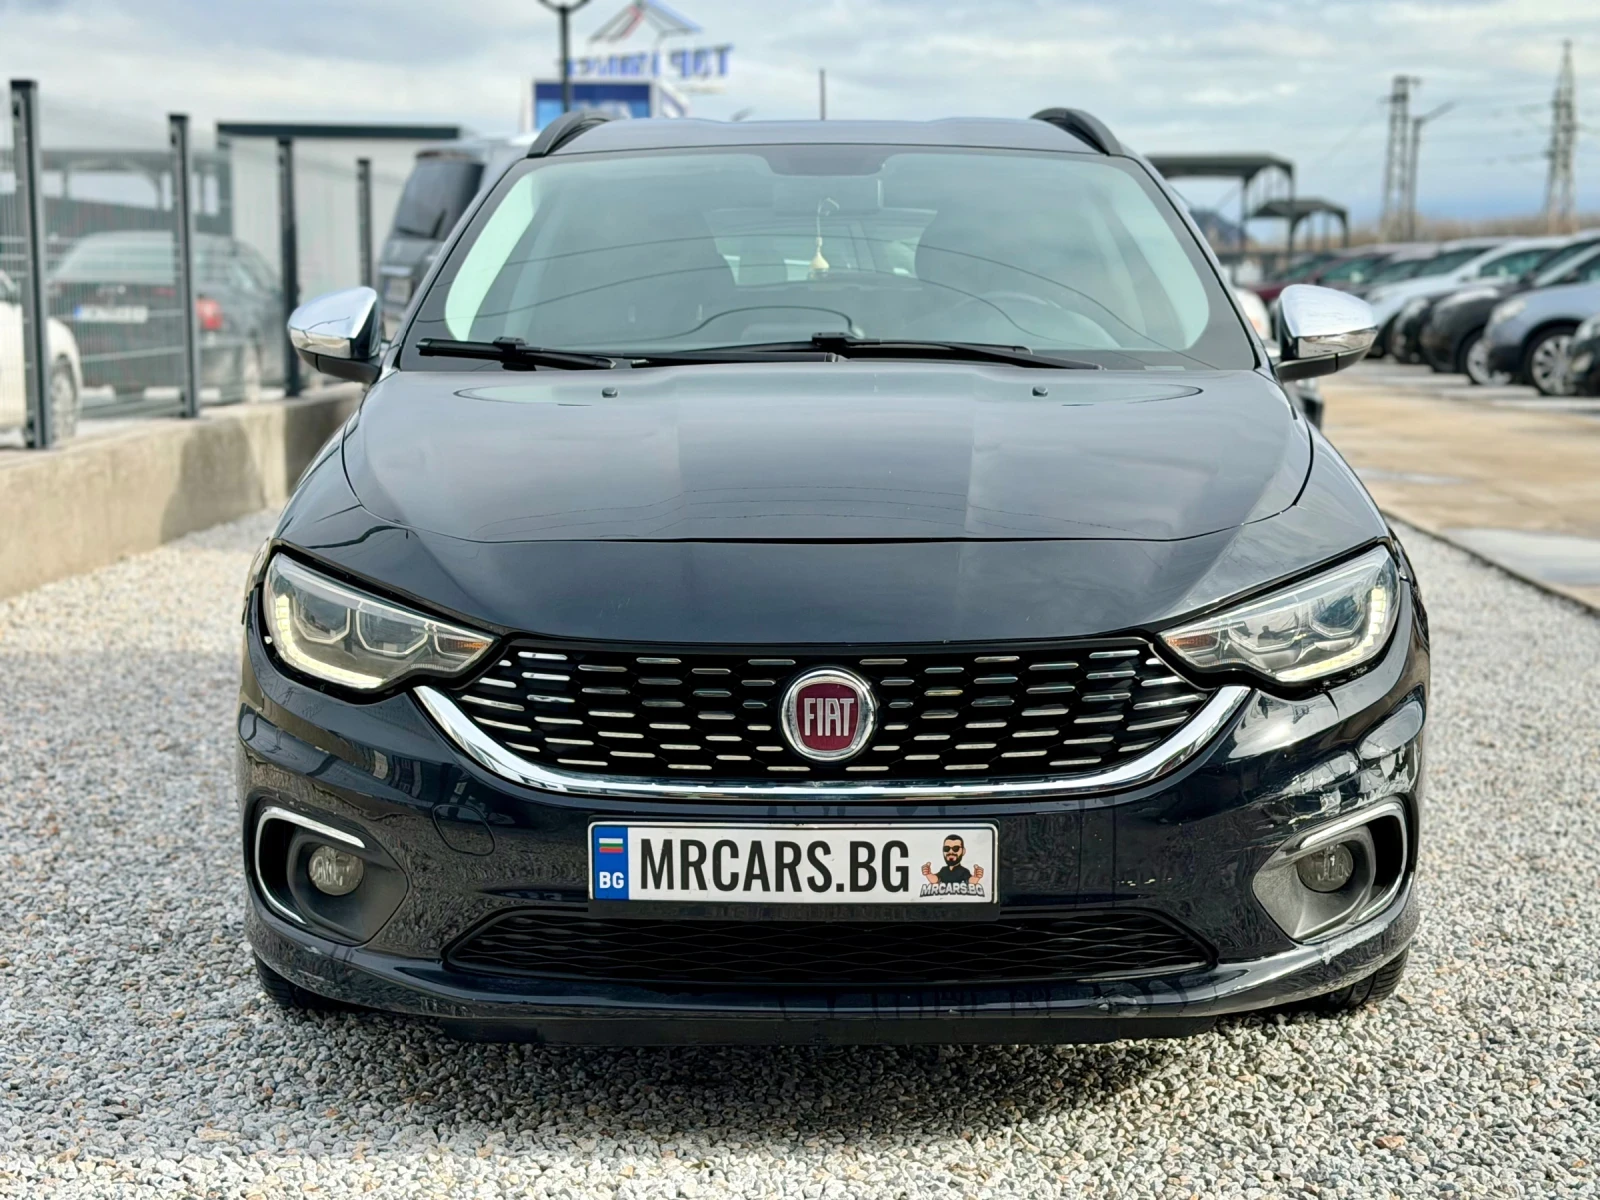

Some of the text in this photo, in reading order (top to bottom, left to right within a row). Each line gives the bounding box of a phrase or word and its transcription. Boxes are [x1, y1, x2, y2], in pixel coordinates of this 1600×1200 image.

[803, 697, 855, 737] FIAT
[599, 871, 625, 889] BG
[640, 838, 910, 893] MRCARS.BG
[919, 881, 986, 898] MRCARS.BG
